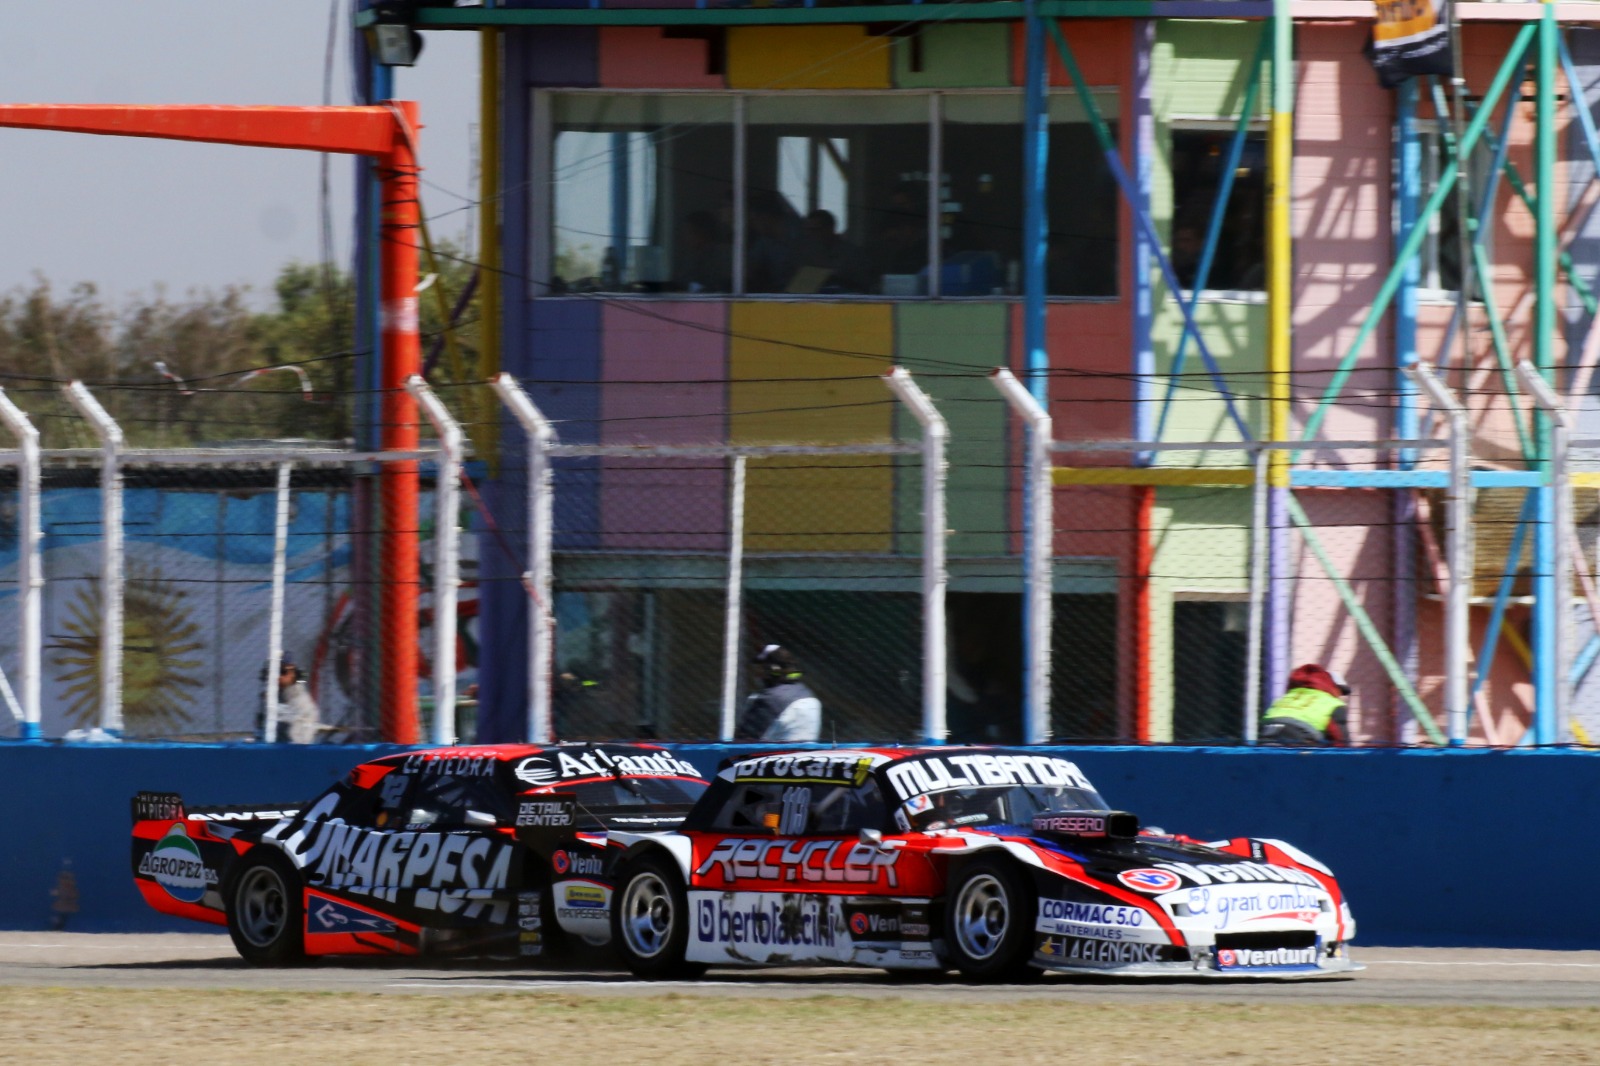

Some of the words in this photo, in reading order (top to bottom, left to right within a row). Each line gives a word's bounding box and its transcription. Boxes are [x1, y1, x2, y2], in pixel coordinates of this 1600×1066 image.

[425, 755, 497, 777] PIEDRA
[558, 748, 702, 778] Atlantis
[519, 802, 565, 815] DETAIL
[516, 814, 570, 826] CENTER
[140, 853, 203, 879] AGROPEZ
[1042, 900, 1114, 925] CORMAC
[1116, 907, 1143, 927] 5.0
[1214, 889, 1264, 930] gran
[1055, 923, 1123, 940] MATERIALES
[1234, 948, 1317, 967] Venturi
